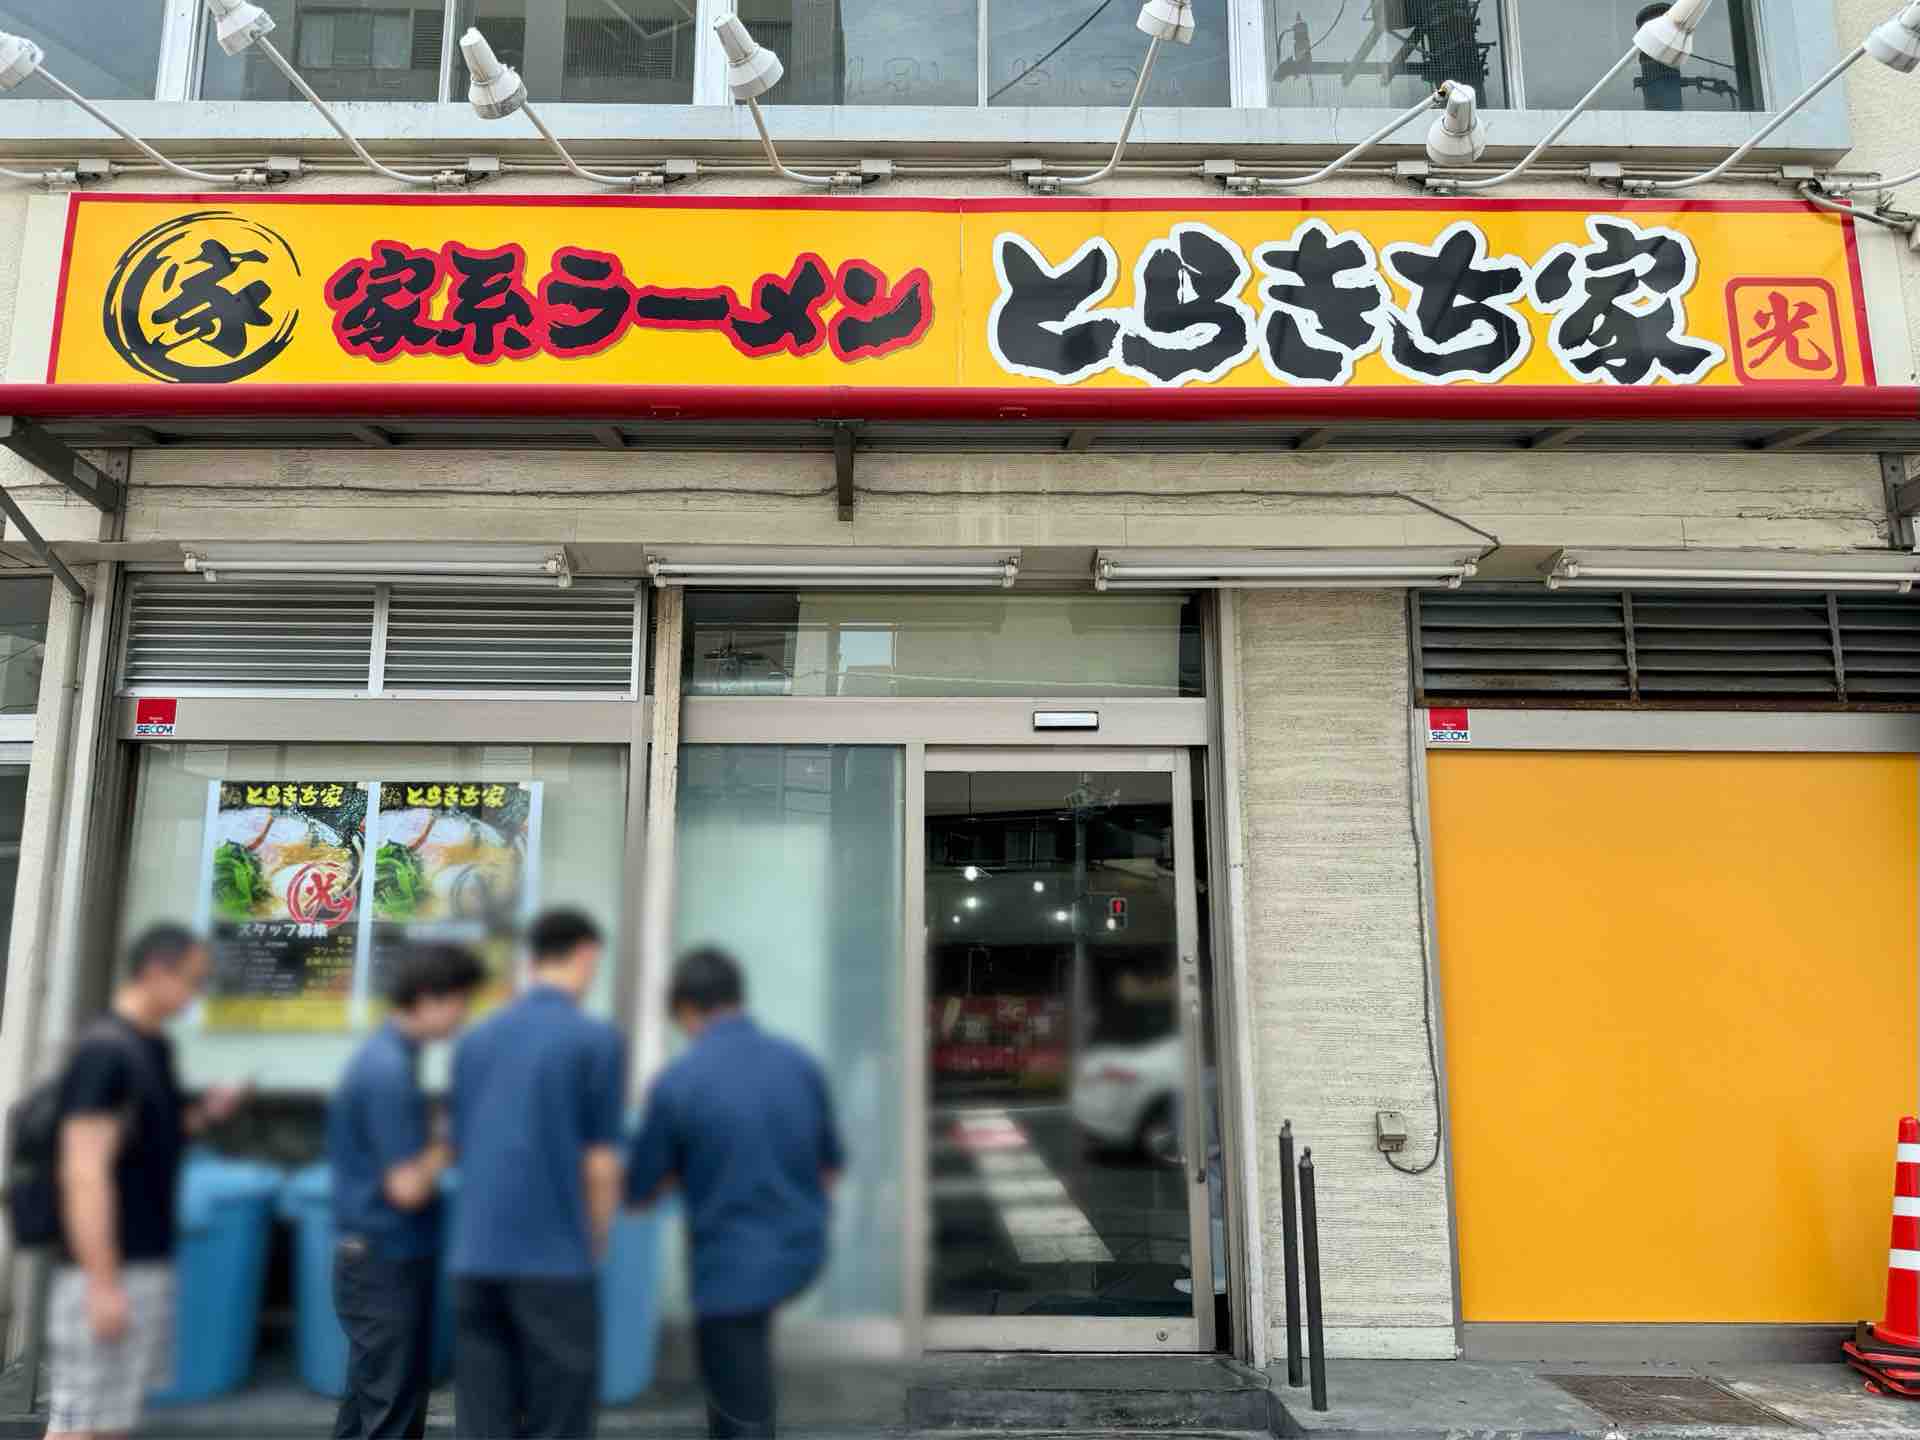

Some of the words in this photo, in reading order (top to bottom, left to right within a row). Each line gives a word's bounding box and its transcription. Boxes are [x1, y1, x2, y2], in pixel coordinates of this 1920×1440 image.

[328, 243, 928, 360] 家系ラーメン
[993, 217, 1721, 385] とらきち家
[1747, 289, 1835, 370] 光
[137, 725, 173, 734] SECOM
[1431, 731, 1468, 740] SECOM
[246, 784, 344, 807] とらきち家
[407, 784, 505, 807] とらきち家
